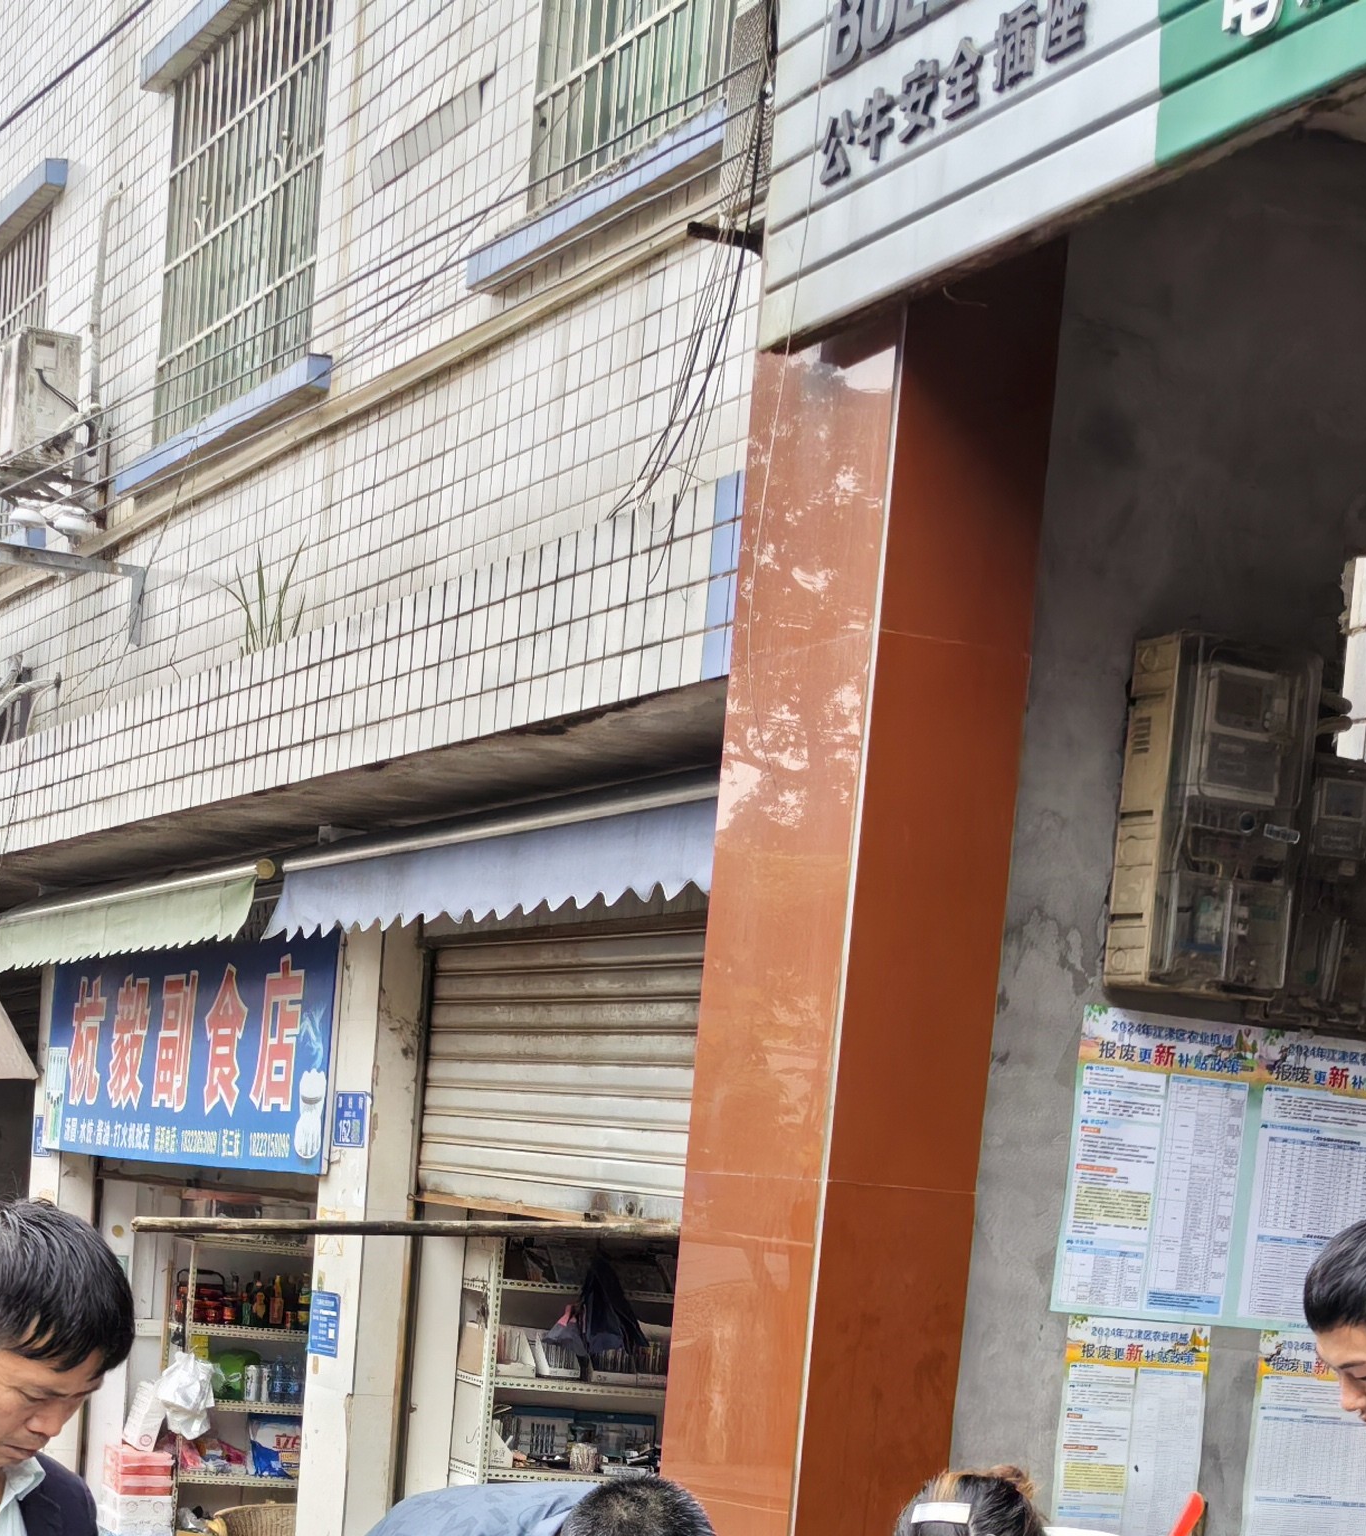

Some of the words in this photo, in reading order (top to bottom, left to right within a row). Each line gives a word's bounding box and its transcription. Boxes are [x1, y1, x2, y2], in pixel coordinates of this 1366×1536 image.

[819, 0, 1087, 187] 公牛安全插座
[1099, 1041, 1241, 1075] 报废更新补贴政策
[1281, 1339, 1317, 1353] 2024年
